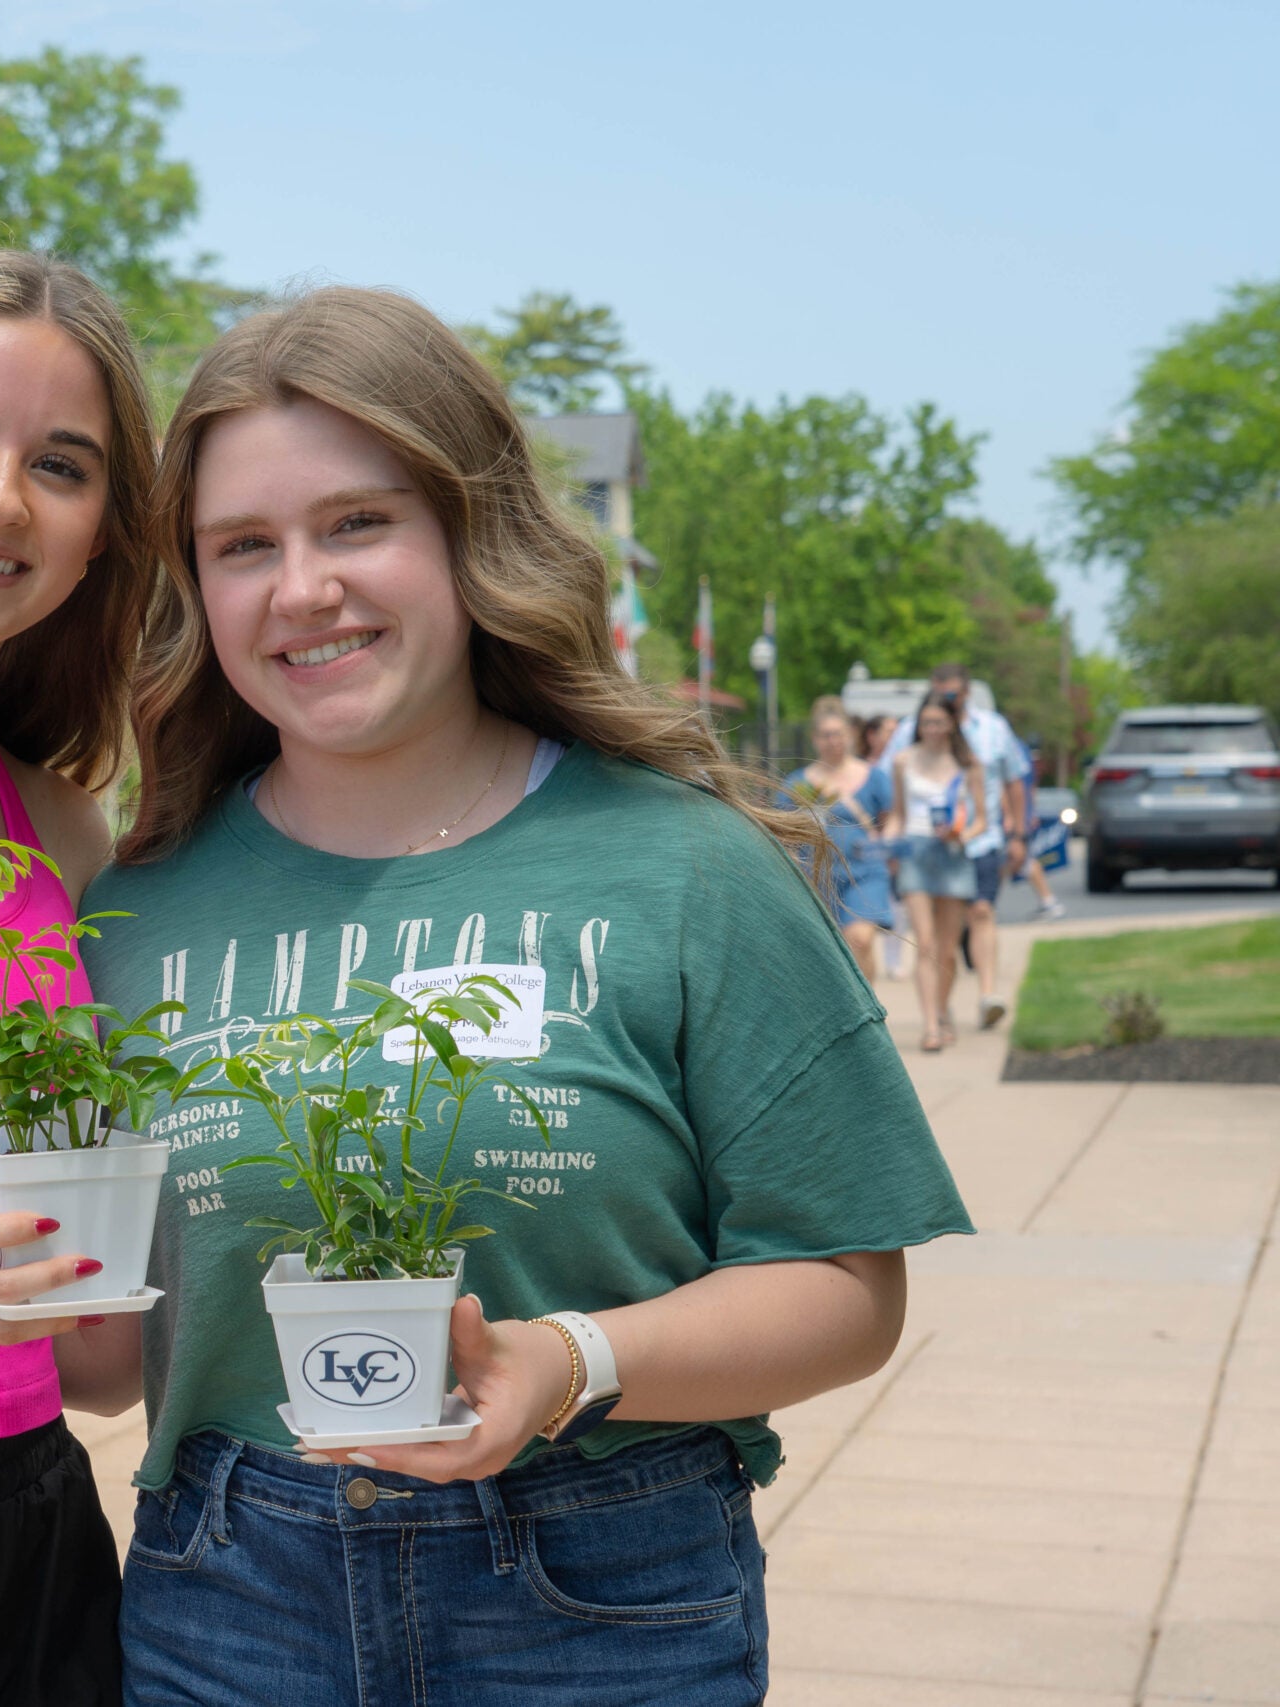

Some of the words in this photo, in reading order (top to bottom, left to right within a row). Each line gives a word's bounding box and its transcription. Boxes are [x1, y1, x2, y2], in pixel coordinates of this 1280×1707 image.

[400, 976, 452, 994] Lebanon
[493, 973, 542, 990] College
[481, 1034, 532, 1049] Pathology
[493, 1084, 581, 1106] TENNIS
[149, 1099, 244, 1139] PERSONAL
[508, 1108, 569, 1129] CLUB
[474, 1149, 597, 1170] SWIMMING
[175, 1166, 224, 1194] POOL
[505, 1176, 565, 1195] POOL
[186, 1192, 227, 1217] BAR
[319, 1350, 400, 1398] LVC
